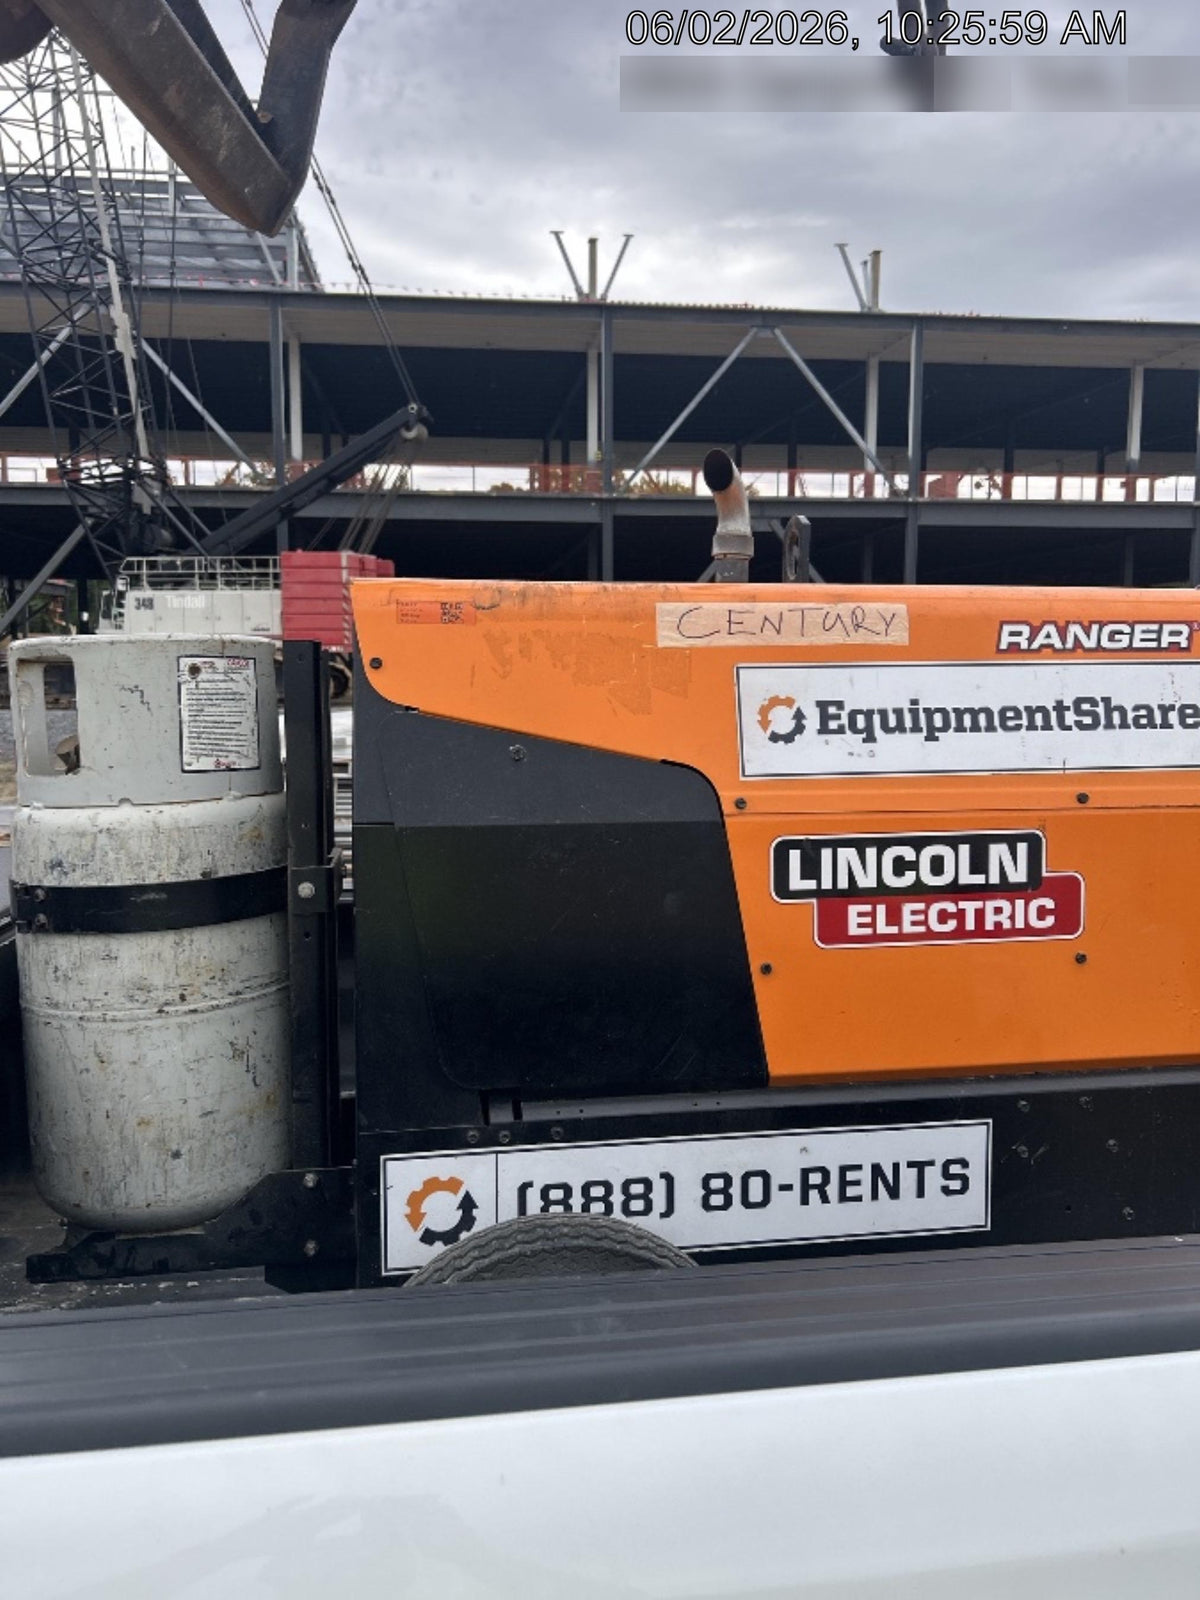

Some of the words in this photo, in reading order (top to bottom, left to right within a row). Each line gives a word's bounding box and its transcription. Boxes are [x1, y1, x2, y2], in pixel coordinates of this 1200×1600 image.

[677, 606, 896, 639] CENTURY
[998, 622, 1191, 651] RANGER
[815, 697, 1200, 744] EquipmentShare
[788, 842, 1029, 891] LINCOLN
[847, 897, 1056, 936] ELECTRIC
[517, 1171, 675, 1220] (888)
[700, 1157, 971, 1213] 80-RENTS
